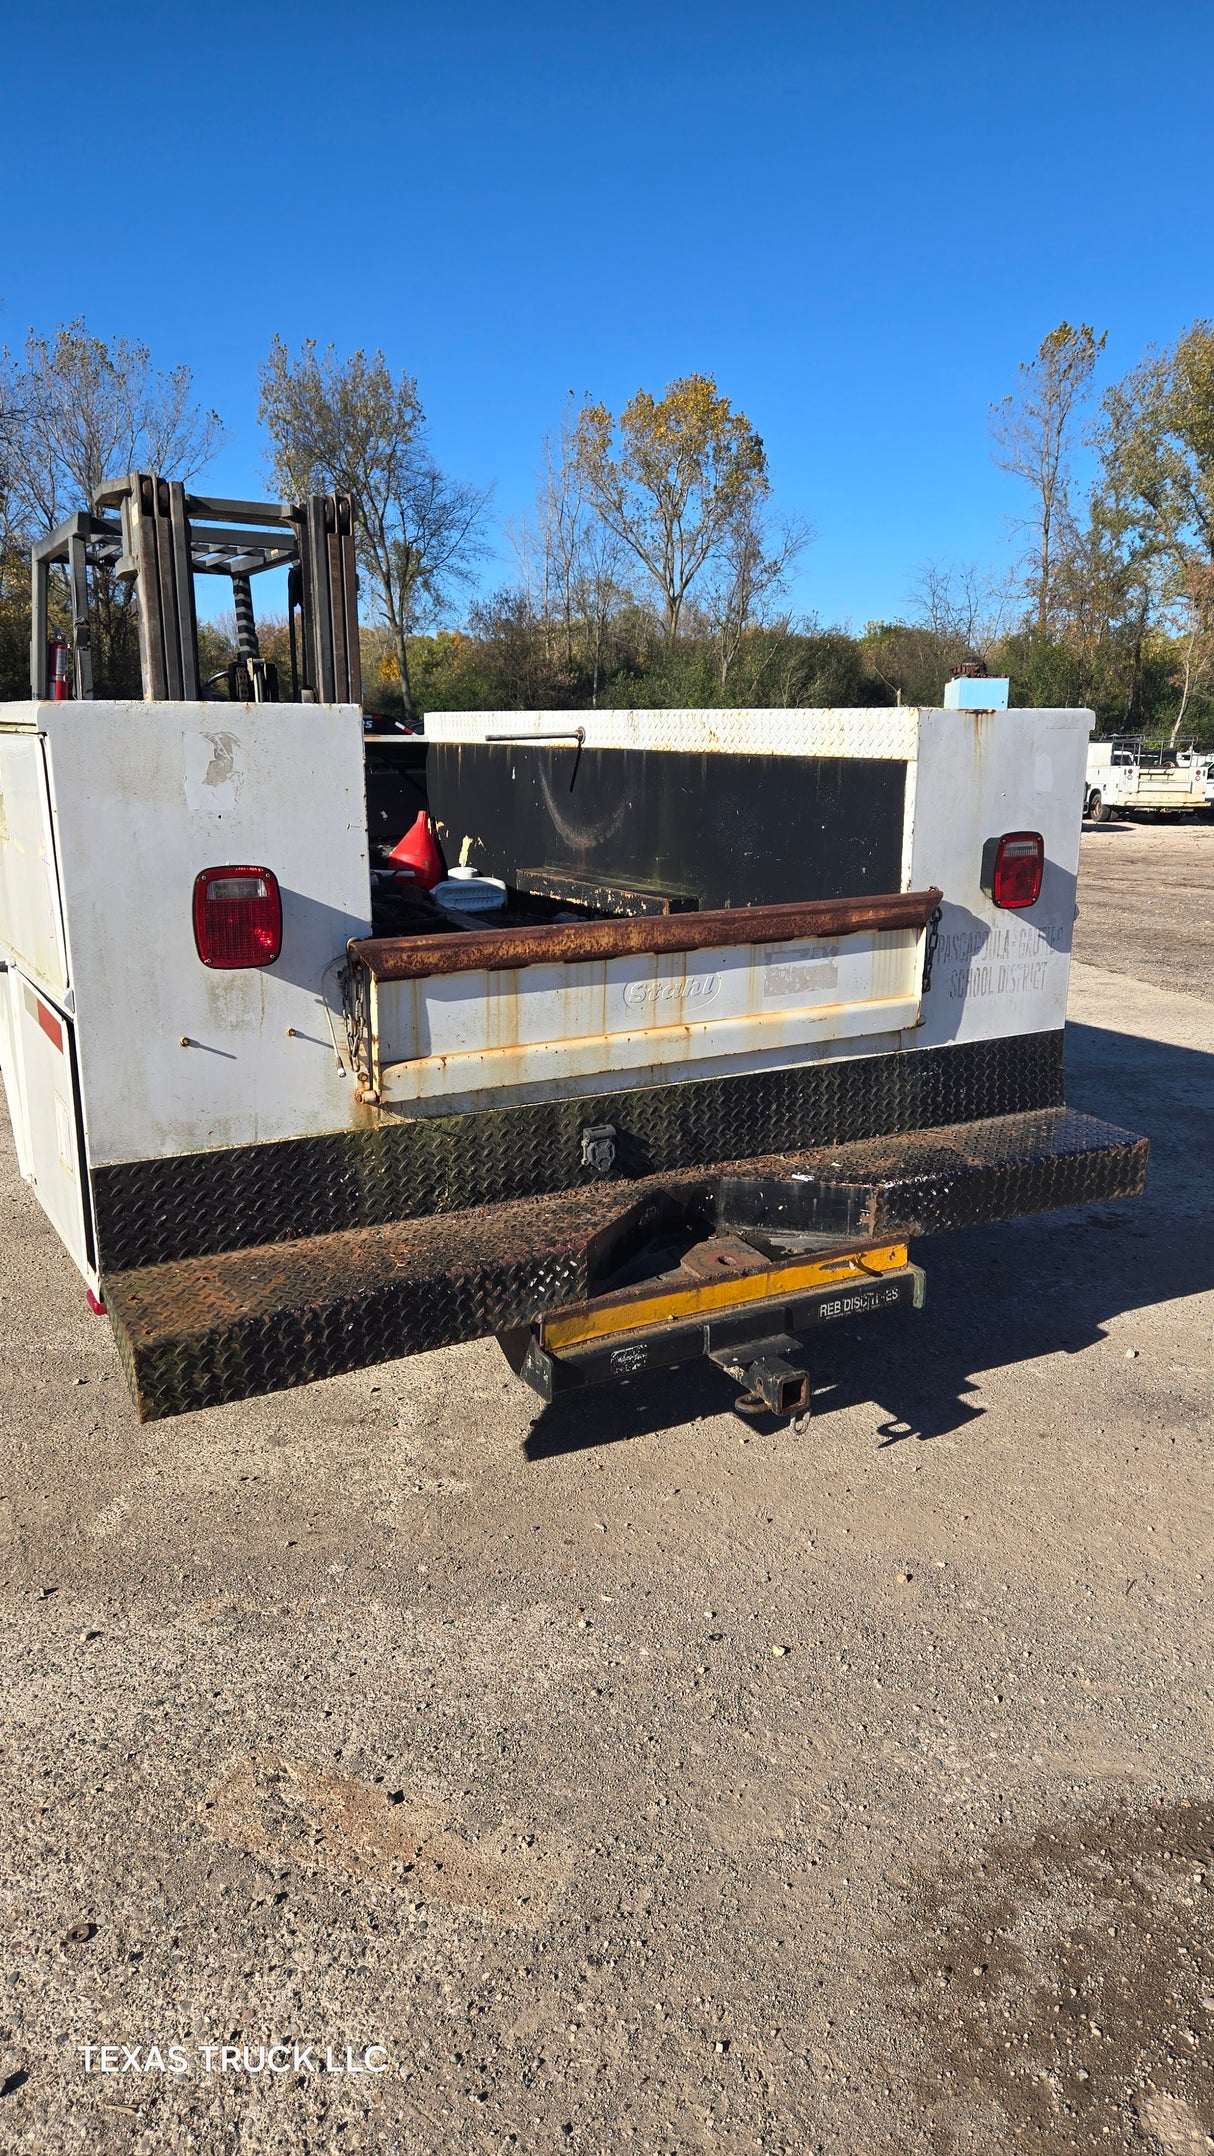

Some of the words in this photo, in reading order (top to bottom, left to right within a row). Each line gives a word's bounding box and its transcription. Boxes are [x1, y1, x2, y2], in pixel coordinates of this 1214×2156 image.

[628, 975, 715, 1003] Stahl
[950, 965, 994, 999] SCHOOL
[998, 961, 1048, 994] DISTRICT
